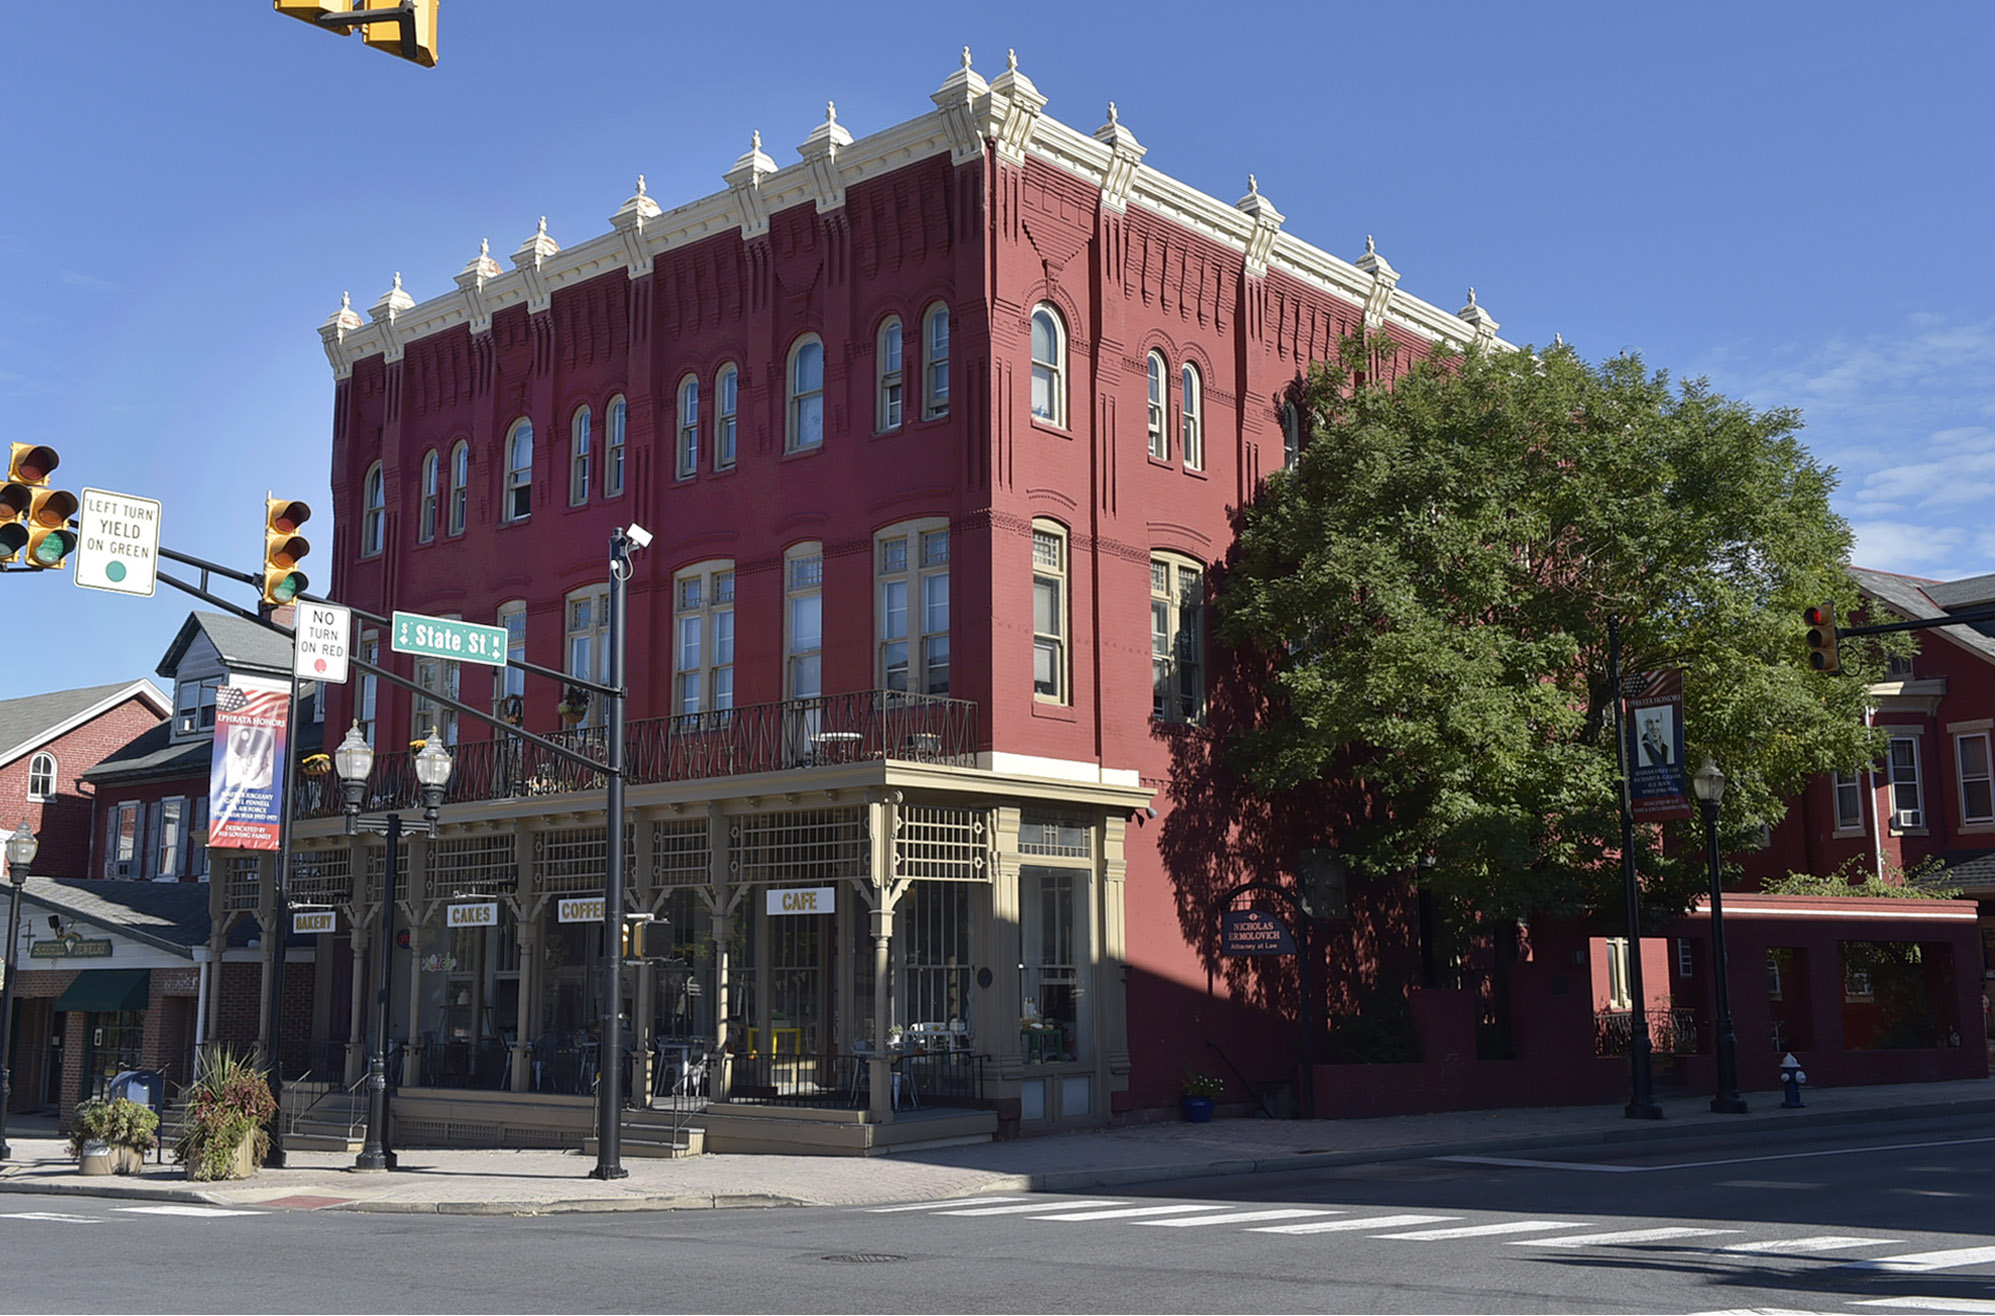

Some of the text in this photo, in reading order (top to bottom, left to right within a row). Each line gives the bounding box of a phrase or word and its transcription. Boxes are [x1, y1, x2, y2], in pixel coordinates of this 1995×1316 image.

[89, 499, 153, 521] LEFT TURN
[100, 519, 141, 539] YIELD
[87, 537, 149, 558] ON GREEN
[313, 610, 335, 626] NO
[309, 627, 338, 641] TURN
[401, 622, 408, 635] S
[415, 624, 461, 651] State
[468, 632, 486, 655] St
[301, 641, 344, 657] ON RED
[1654, 694, 1681, 704] HONORS
[218, 714, 286, 728] EPHRATA HONORS
[782, 892, 817, 910] CAFE
[296, 914, 332, 930] BAKERY
[452, 907, 491, 923] CAKES
[1233, 921, 1274, 931] NICHOLAS
[1228, 931, 1280, 940] ERMOLOVICH
[1231, 943, 1255, 951] Attorney
